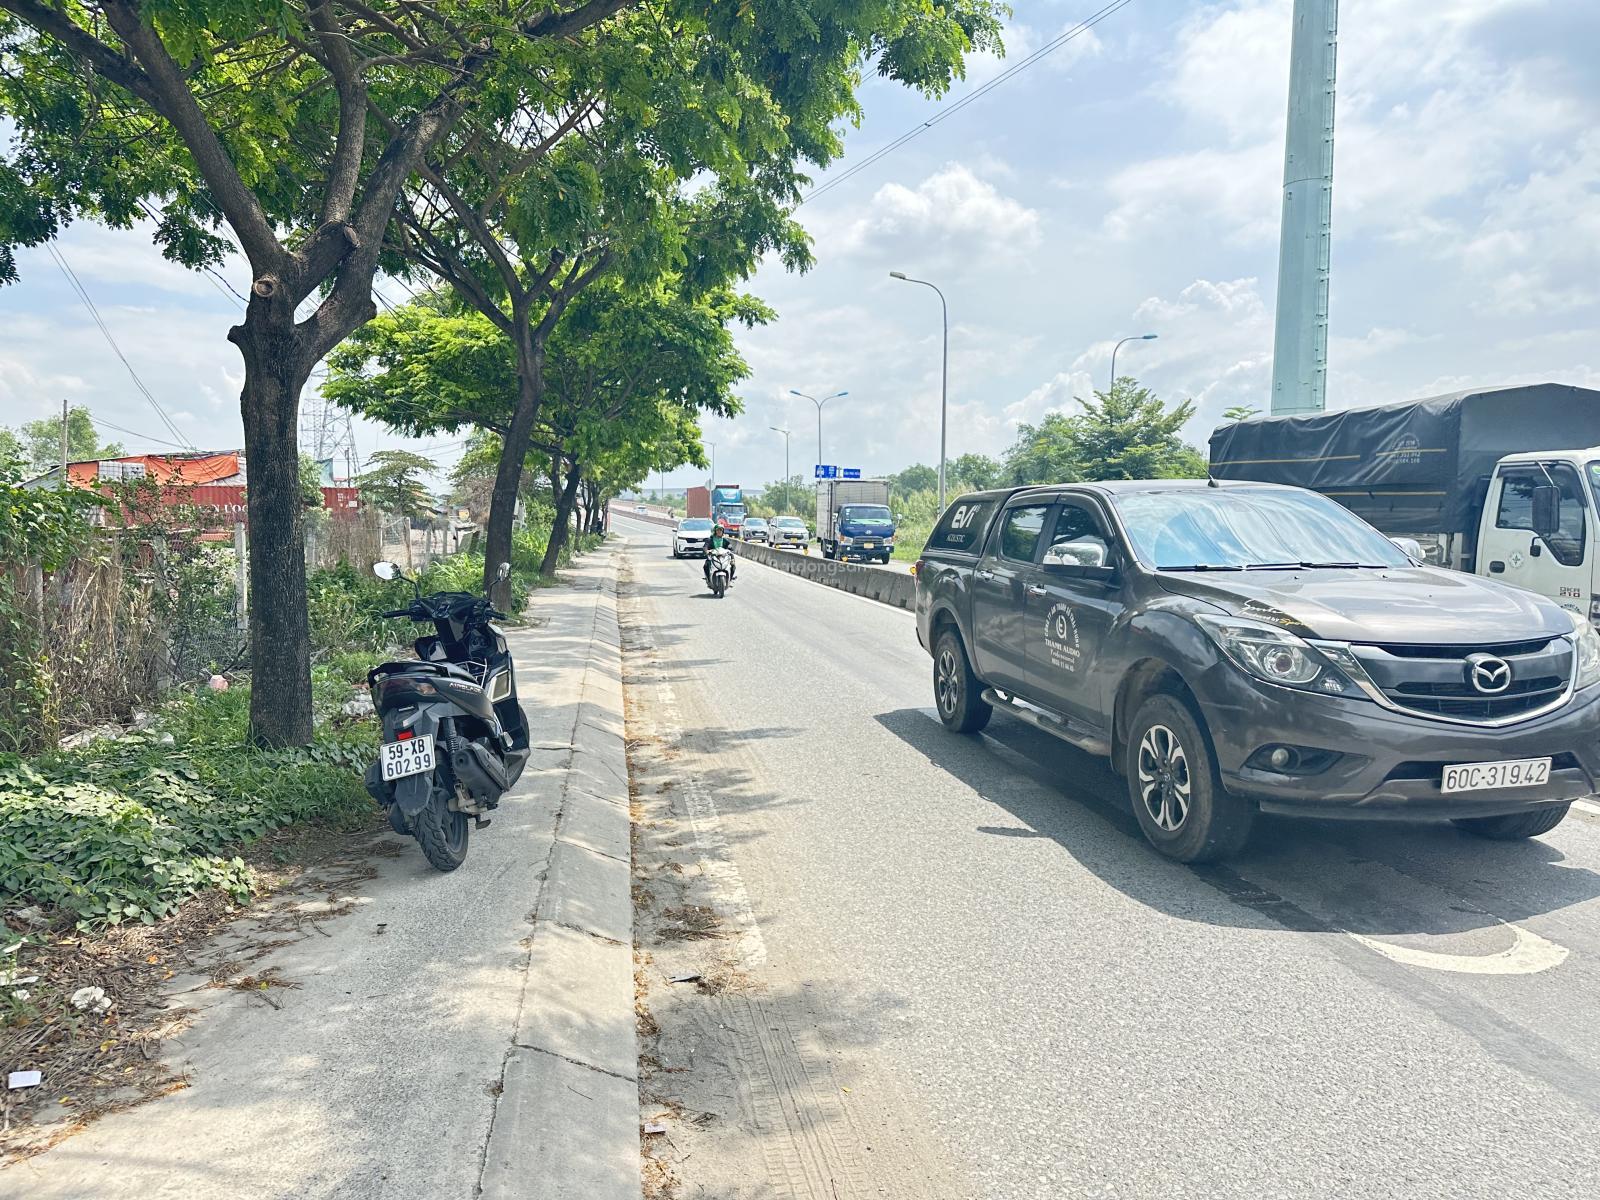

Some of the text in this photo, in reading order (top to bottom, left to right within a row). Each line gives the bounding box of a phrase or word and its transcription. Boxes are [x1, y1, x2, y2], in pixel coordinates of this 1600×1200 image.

[388, 738, 425, 761] 59-XB
[386, 753, 431, 777] 602.99
[1446, 762, 1547, 790] 60C-319.42
